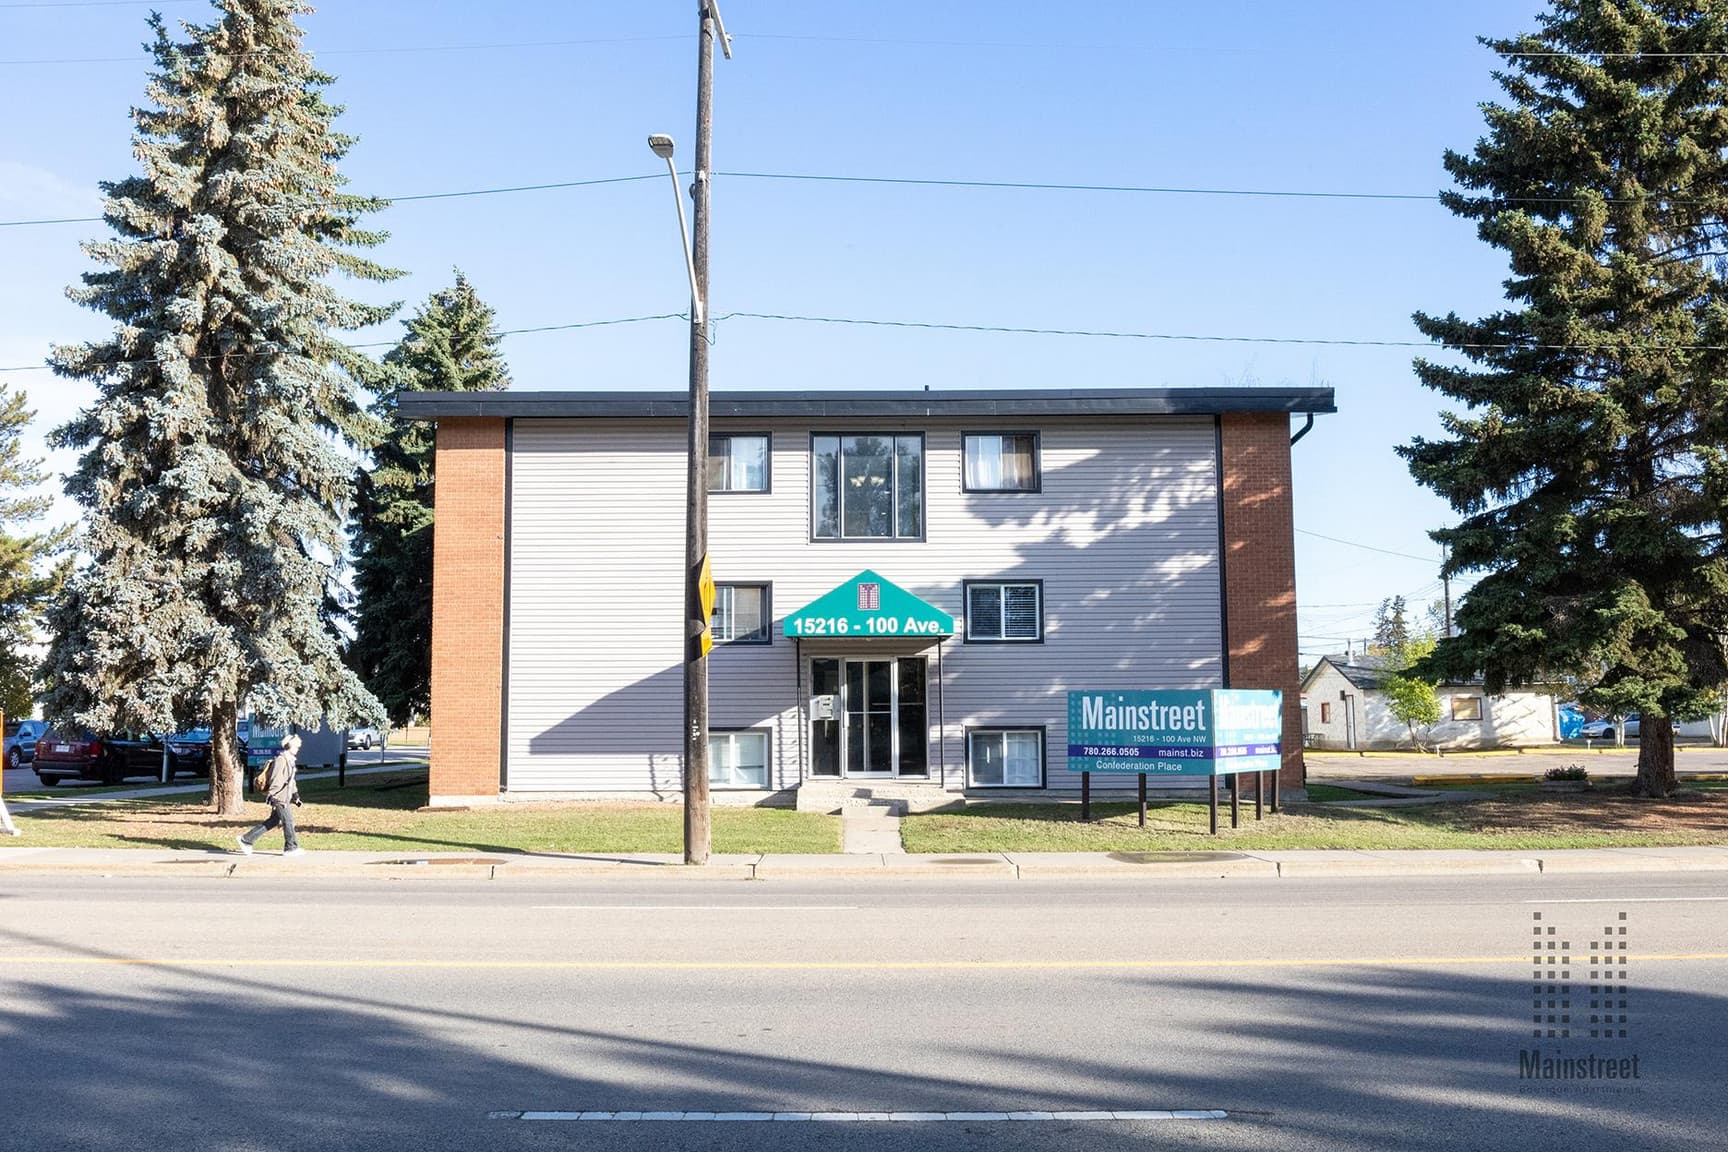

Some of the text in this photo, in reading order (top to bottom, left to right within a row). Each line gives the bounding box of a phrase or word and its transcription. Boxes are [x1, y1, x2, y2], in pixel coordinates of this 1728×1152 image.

[793, 618, 848, 633] 15216
[866, 618, 898, 633] 100
[903, 617, 945, 633] Ave.
[1082, 696, 1206, 731] Mainstreet
[1133, 735, 1154, 743] 15216
[1162, 735, 1175, 743] 100
[1177, 735, 1191, 743] Ave
[1193, 735, 1207, 743] NW
[1083, 747, 1204, 758] 780.266.0505 mainst.biz
[1096, 760, 1183, 771] Confederation Place
